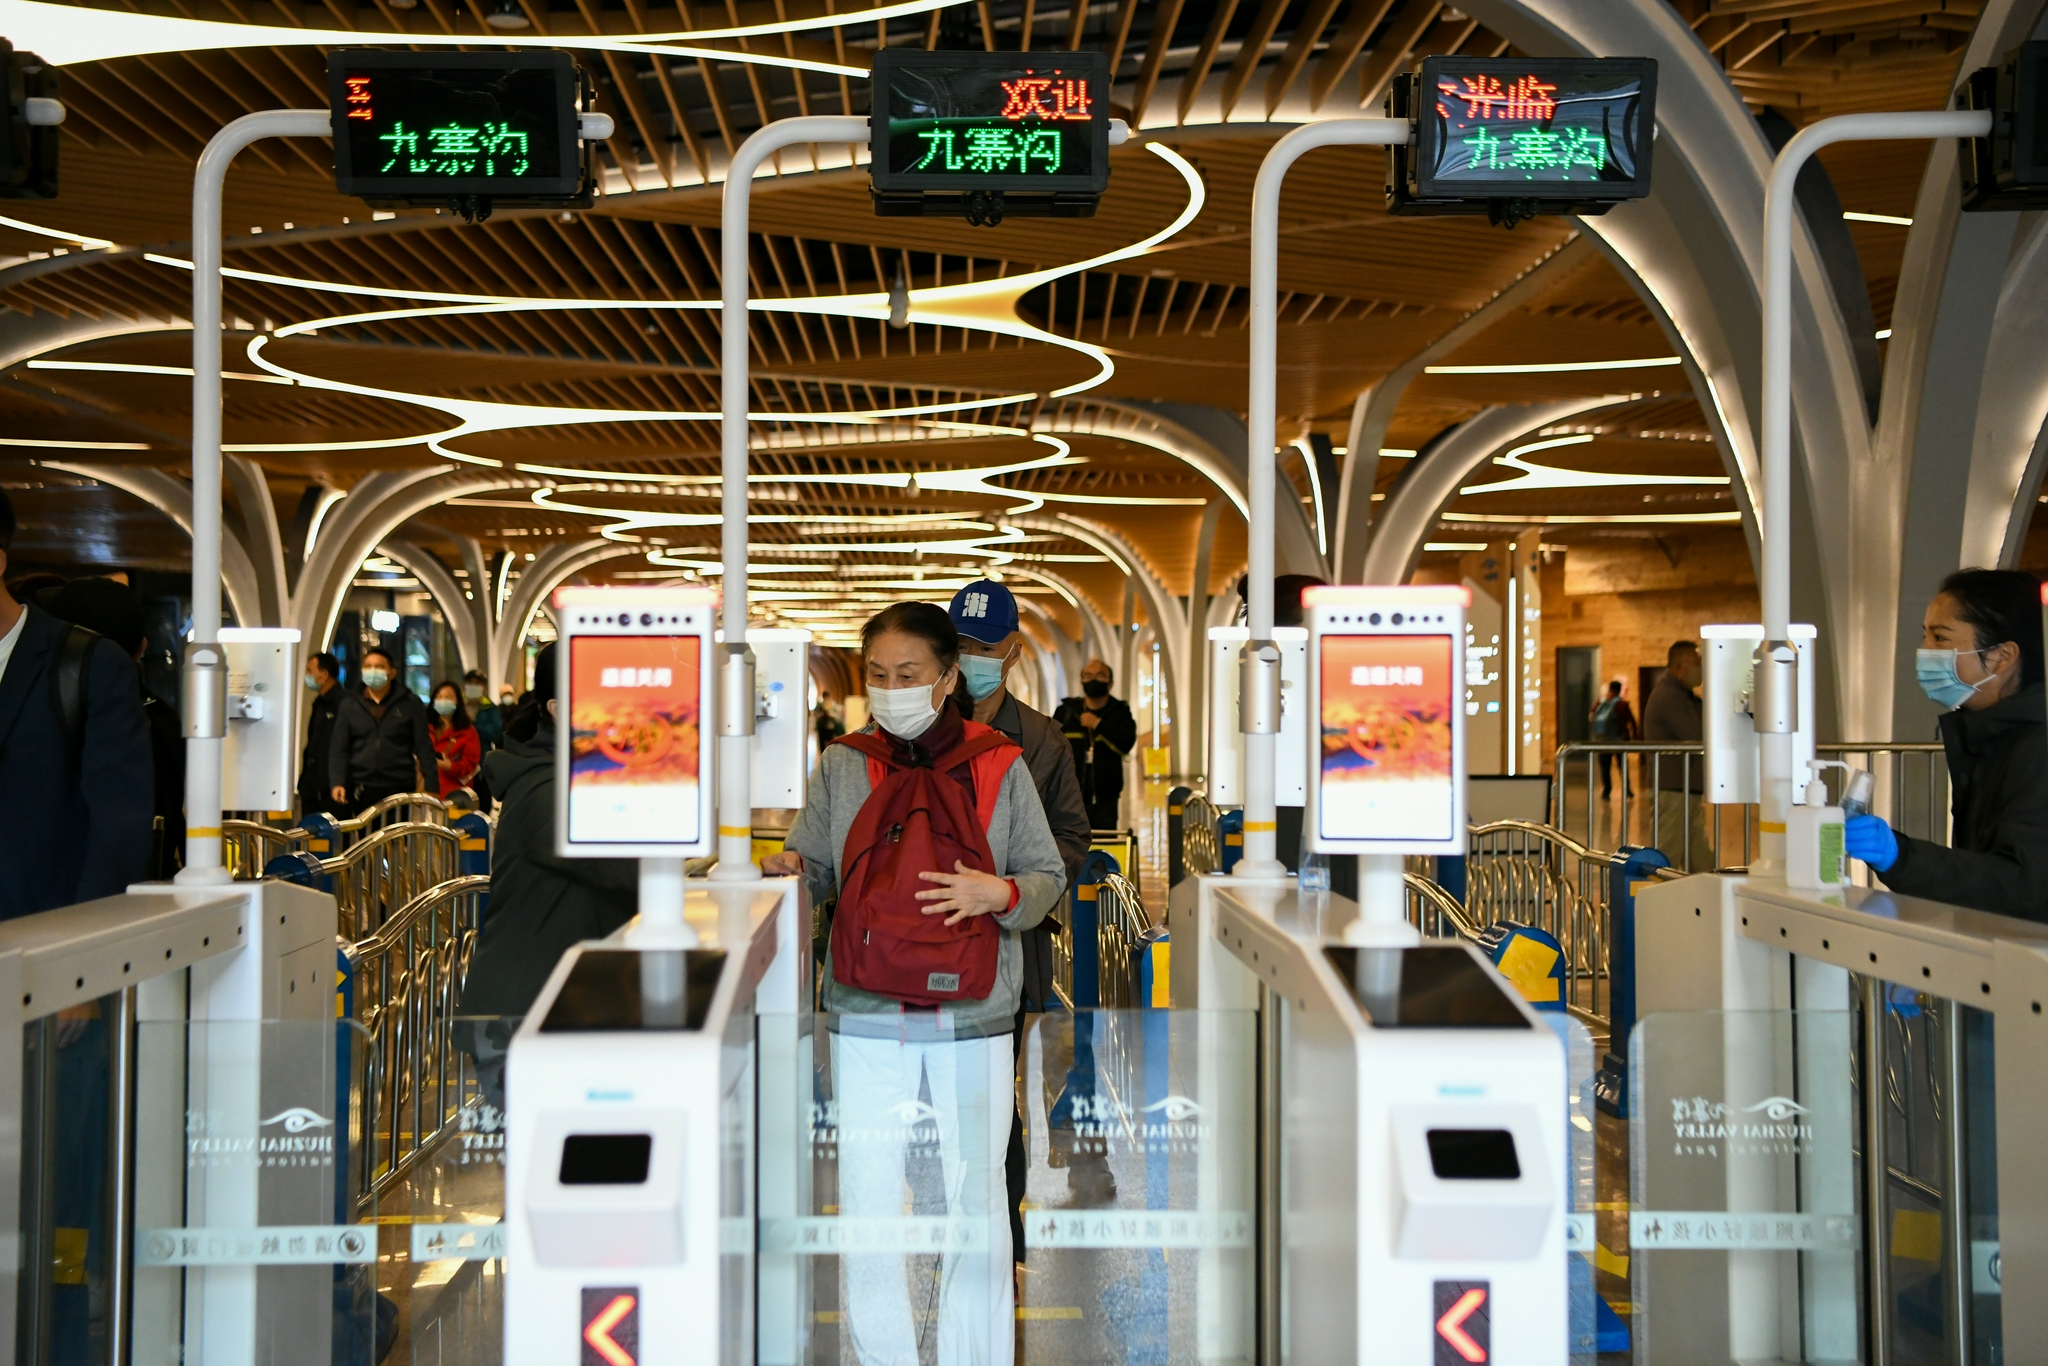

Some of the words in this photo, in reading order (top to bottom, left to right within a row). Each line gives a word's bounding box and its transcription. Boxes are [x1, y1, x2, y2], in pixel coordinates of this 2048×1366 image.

[379, 121, 529, 176] 九寨沟
[918, 121, 1061, 173] 九寨沟
[1463, 126, 1606, 177] 九寨沟
